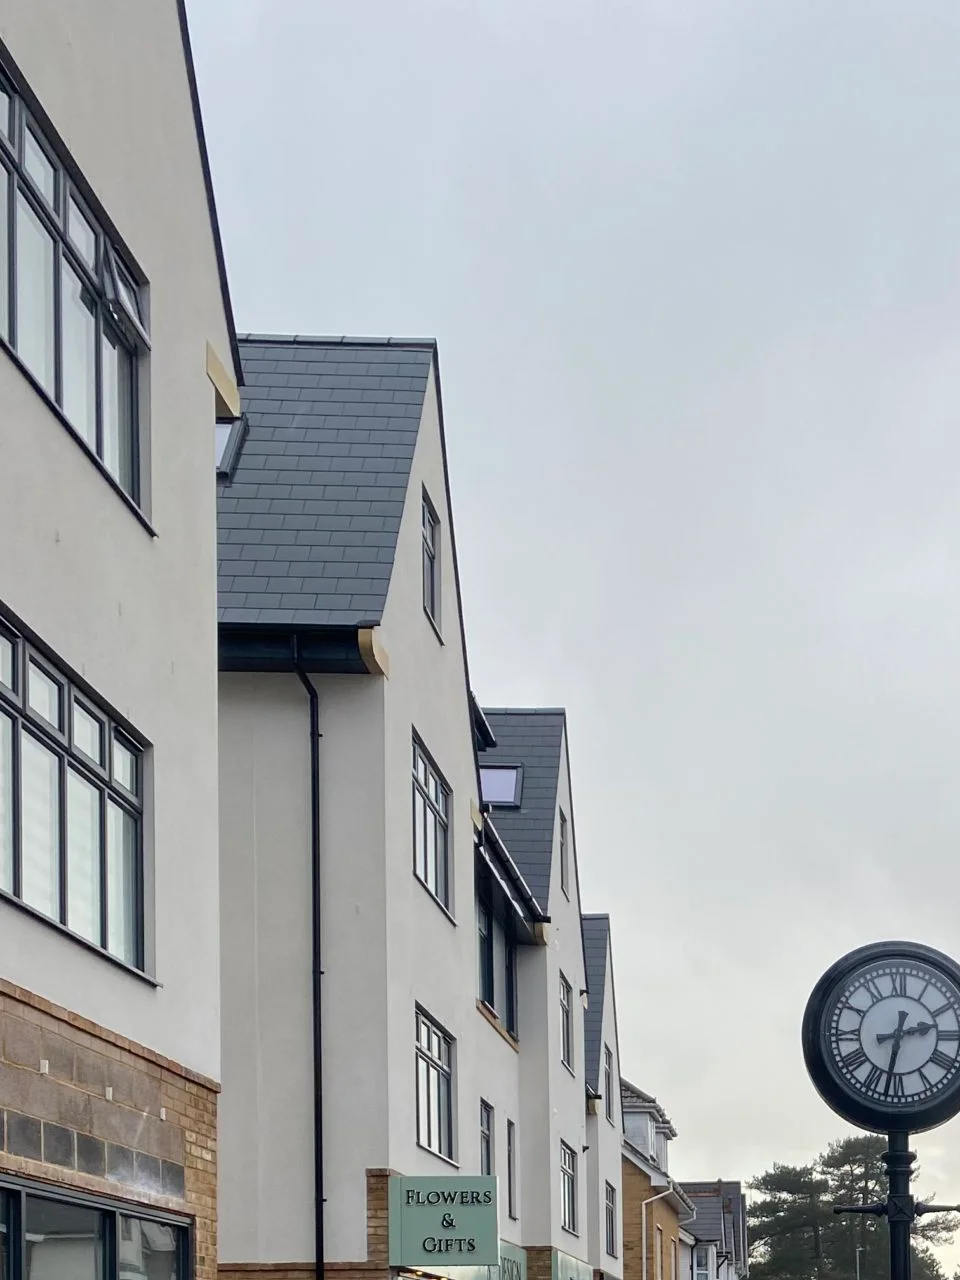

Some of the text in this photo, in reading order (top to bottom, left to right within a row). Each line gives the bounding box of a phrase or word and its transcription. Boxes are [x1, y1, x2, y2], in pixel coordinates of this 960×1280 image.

[865, 979, 883, 1003] XI
[891, 974, 907, 996] XII
[841, 1001, 864, 1016] X
[931, 1003, 953, 1017] II
[938, 1030, 960, 1041] III
[405, 1189, 493, 1205] FLOWERS
[441, 1212, 457, 1228] &
[422, 1236, 476, 1253] GIFTS
